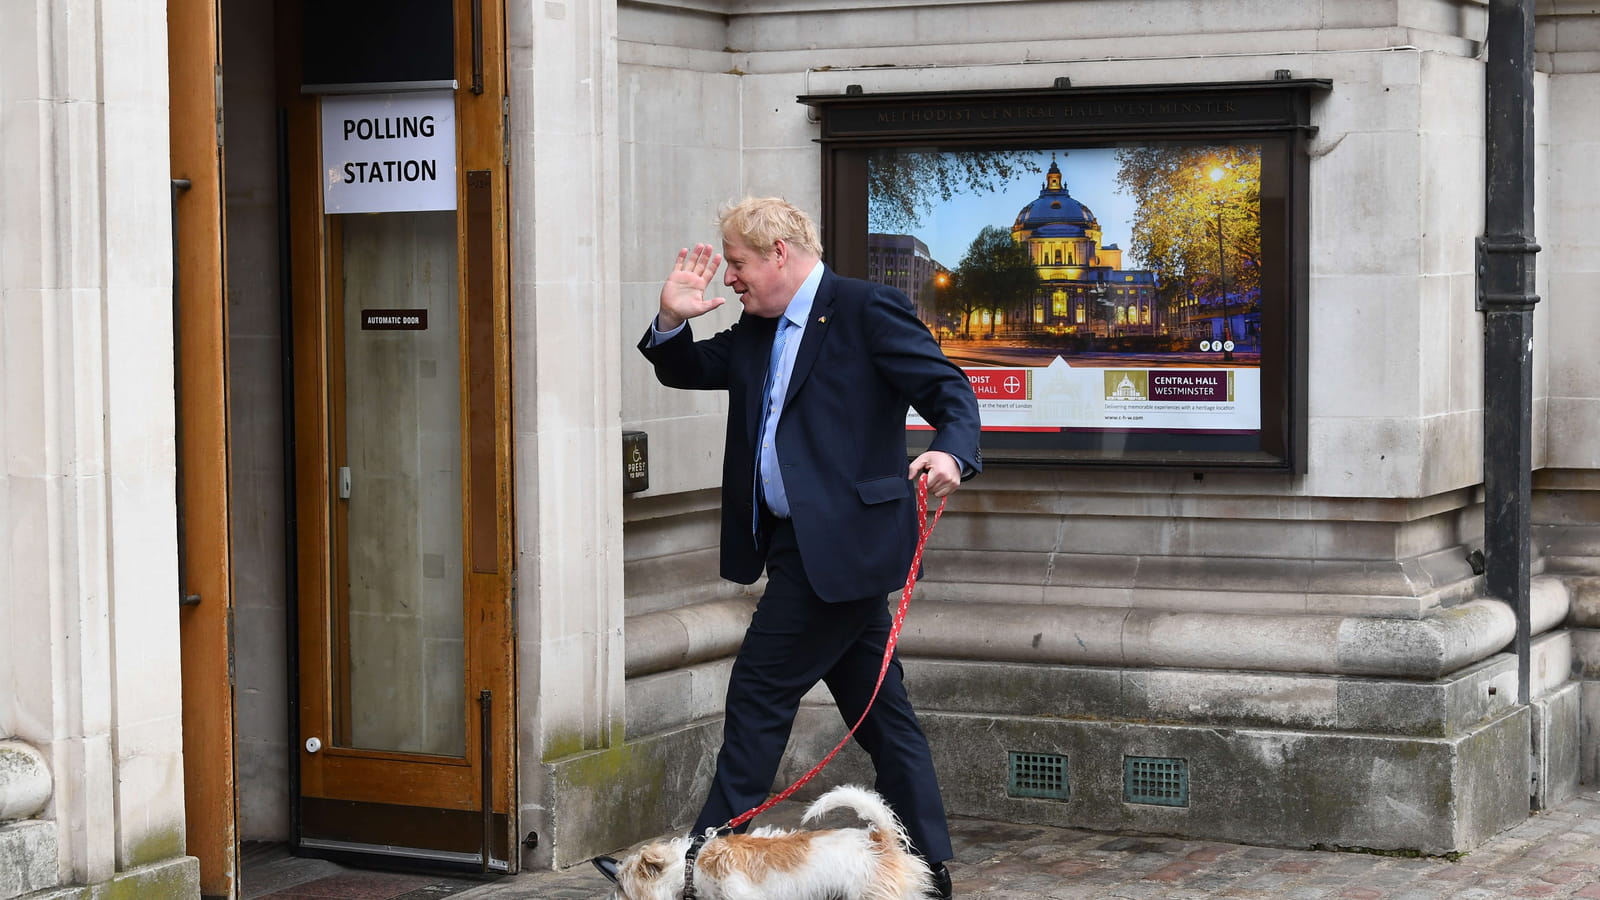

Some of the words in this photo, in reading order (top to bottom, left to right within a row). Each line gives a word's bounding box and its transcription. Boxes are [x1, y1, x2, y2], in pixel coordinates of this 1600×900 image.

[878, 108, 972, 123] METHODIST
[980, 105, 1055, 120] CENTRAL
[1064, 103, 1104, 117] HALL
[1113, 101, 1235, 113] WESTMINSTER
[343, 115, 434, 140] POLLING
[343, 159, 436, 184] STATION
[367, 316, 401, 324] AUTOMATIC
[402, 316, 420, 324] DOOR
[1154, 376, 1194, 385] CENTRAL
[1195, 377, 1218, 386] HALL
[978, 385, 998, 394] HALL
[1154, 387, 1215, 396] WESTMINSTER
